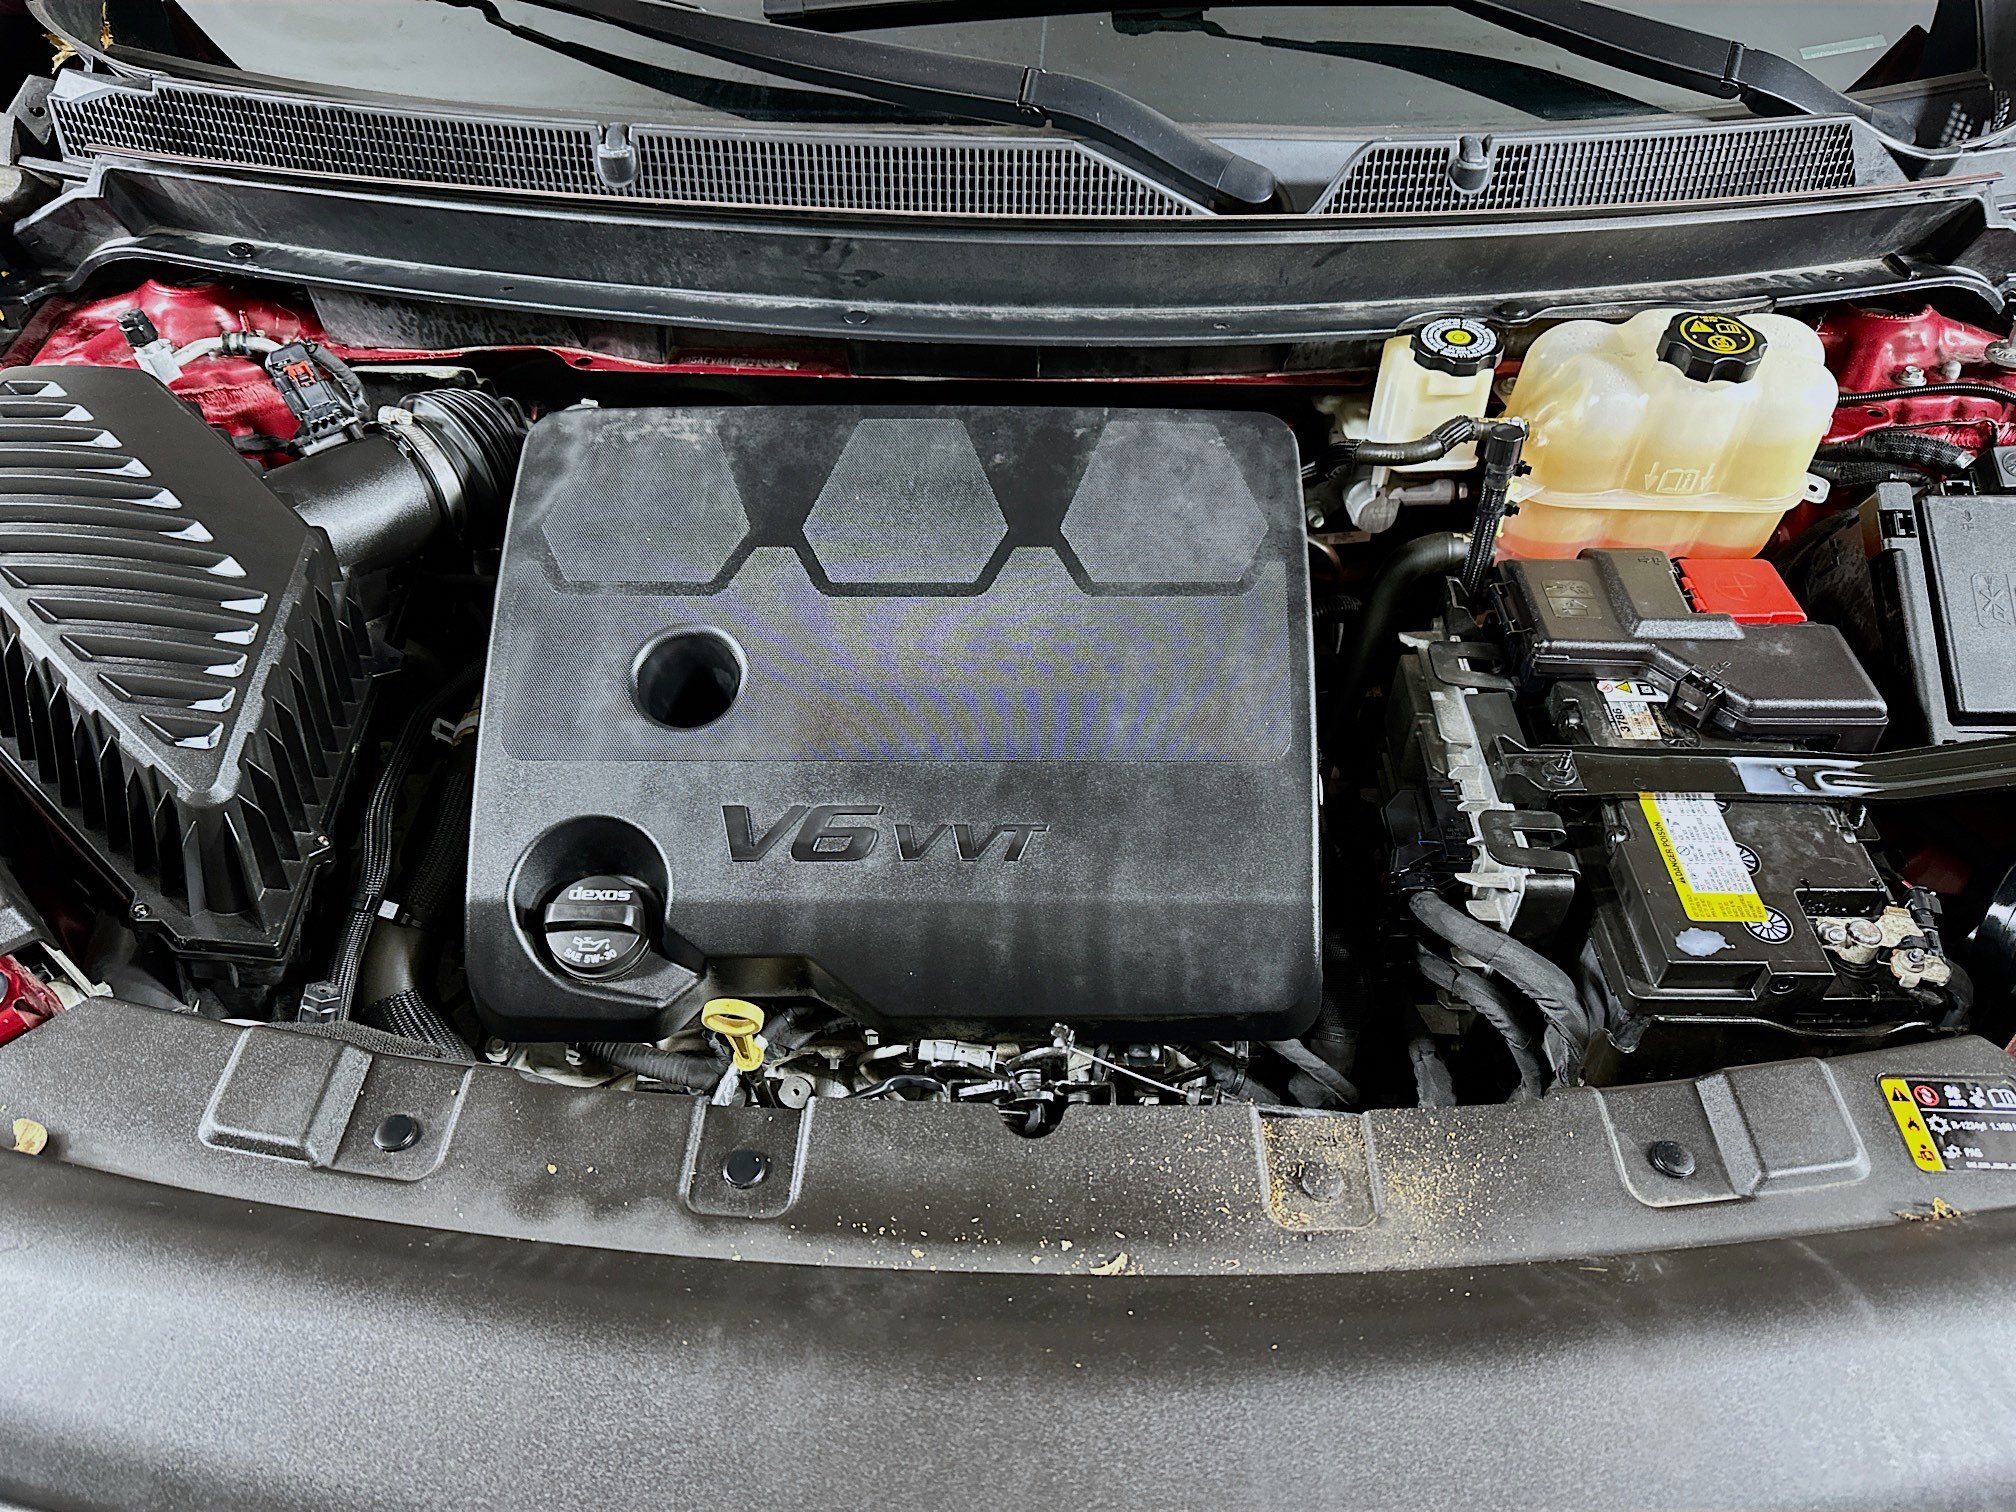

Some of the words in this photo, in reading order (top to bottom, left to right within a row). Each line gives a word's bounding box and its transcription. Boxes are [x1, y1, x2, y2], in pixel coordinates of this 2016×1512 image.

[1612, 708, 1631, 732] 3786
[721, 804, 884, 862] V6
[894, 823, 1050, 862] VVT
[1654, 821, 1668, 847] POISON
[1665, 848, 1683, 877] DANGER
[568, 886, 633, 901] dexos
[563, 948, 583, 962] SAE
[583, 949, 617, 963] 5W-30
